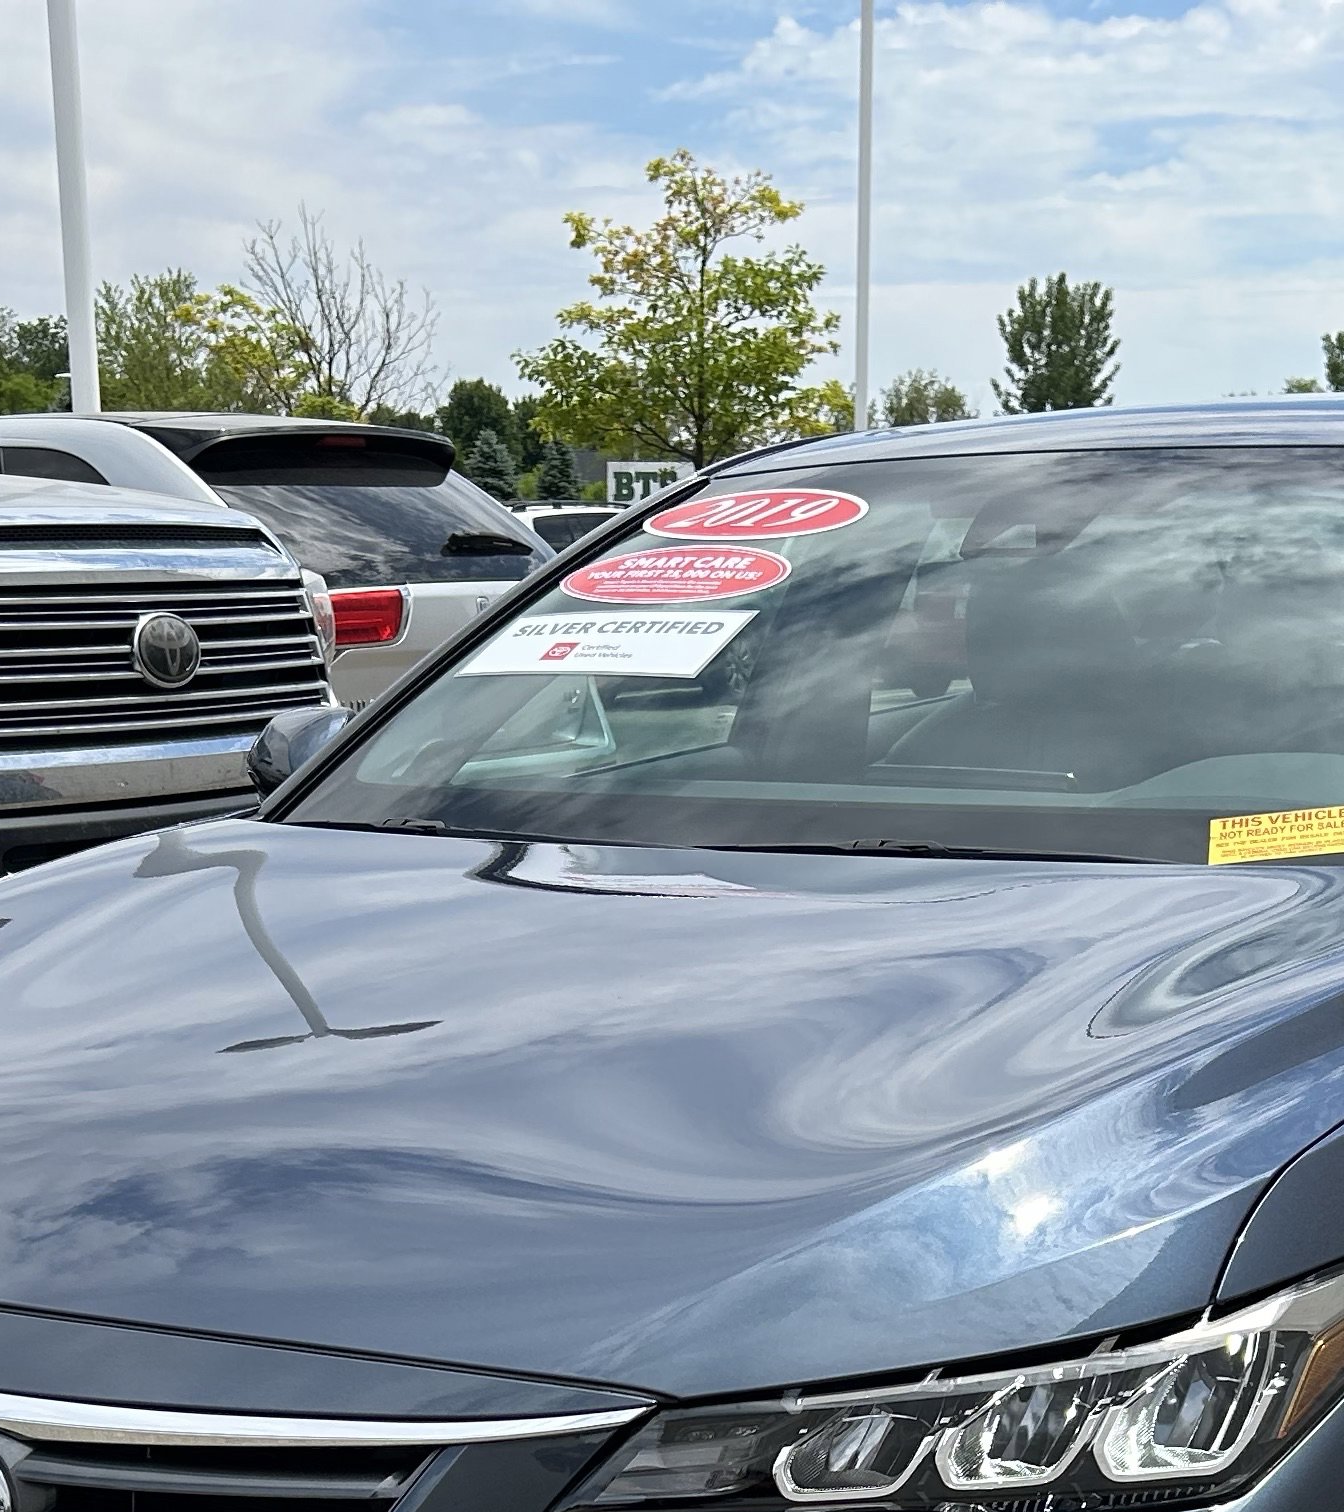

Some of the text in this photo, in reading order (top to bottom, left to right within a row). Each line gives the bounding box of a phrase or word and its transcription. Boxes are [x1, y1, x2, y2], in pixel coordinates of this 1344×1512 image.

[664, 498, 840, 529] 2019
[618, 556, 757, 570] SMART CARE
[587, 570, 625, 580] YOUR
[623, 570, 665, 579] FIRST
[710, 569, 740, 580] ON
[512, 620, 725, 638] SILVER CERTIFIED
[581, 644, 622, 652] Certified
[1219, 816, 1263, 830] THIS
[1219, 830, 1243, 841] NOT
[1246, 825, 1287, 838] READY
[1289, 823, 1314, 833] FOR
